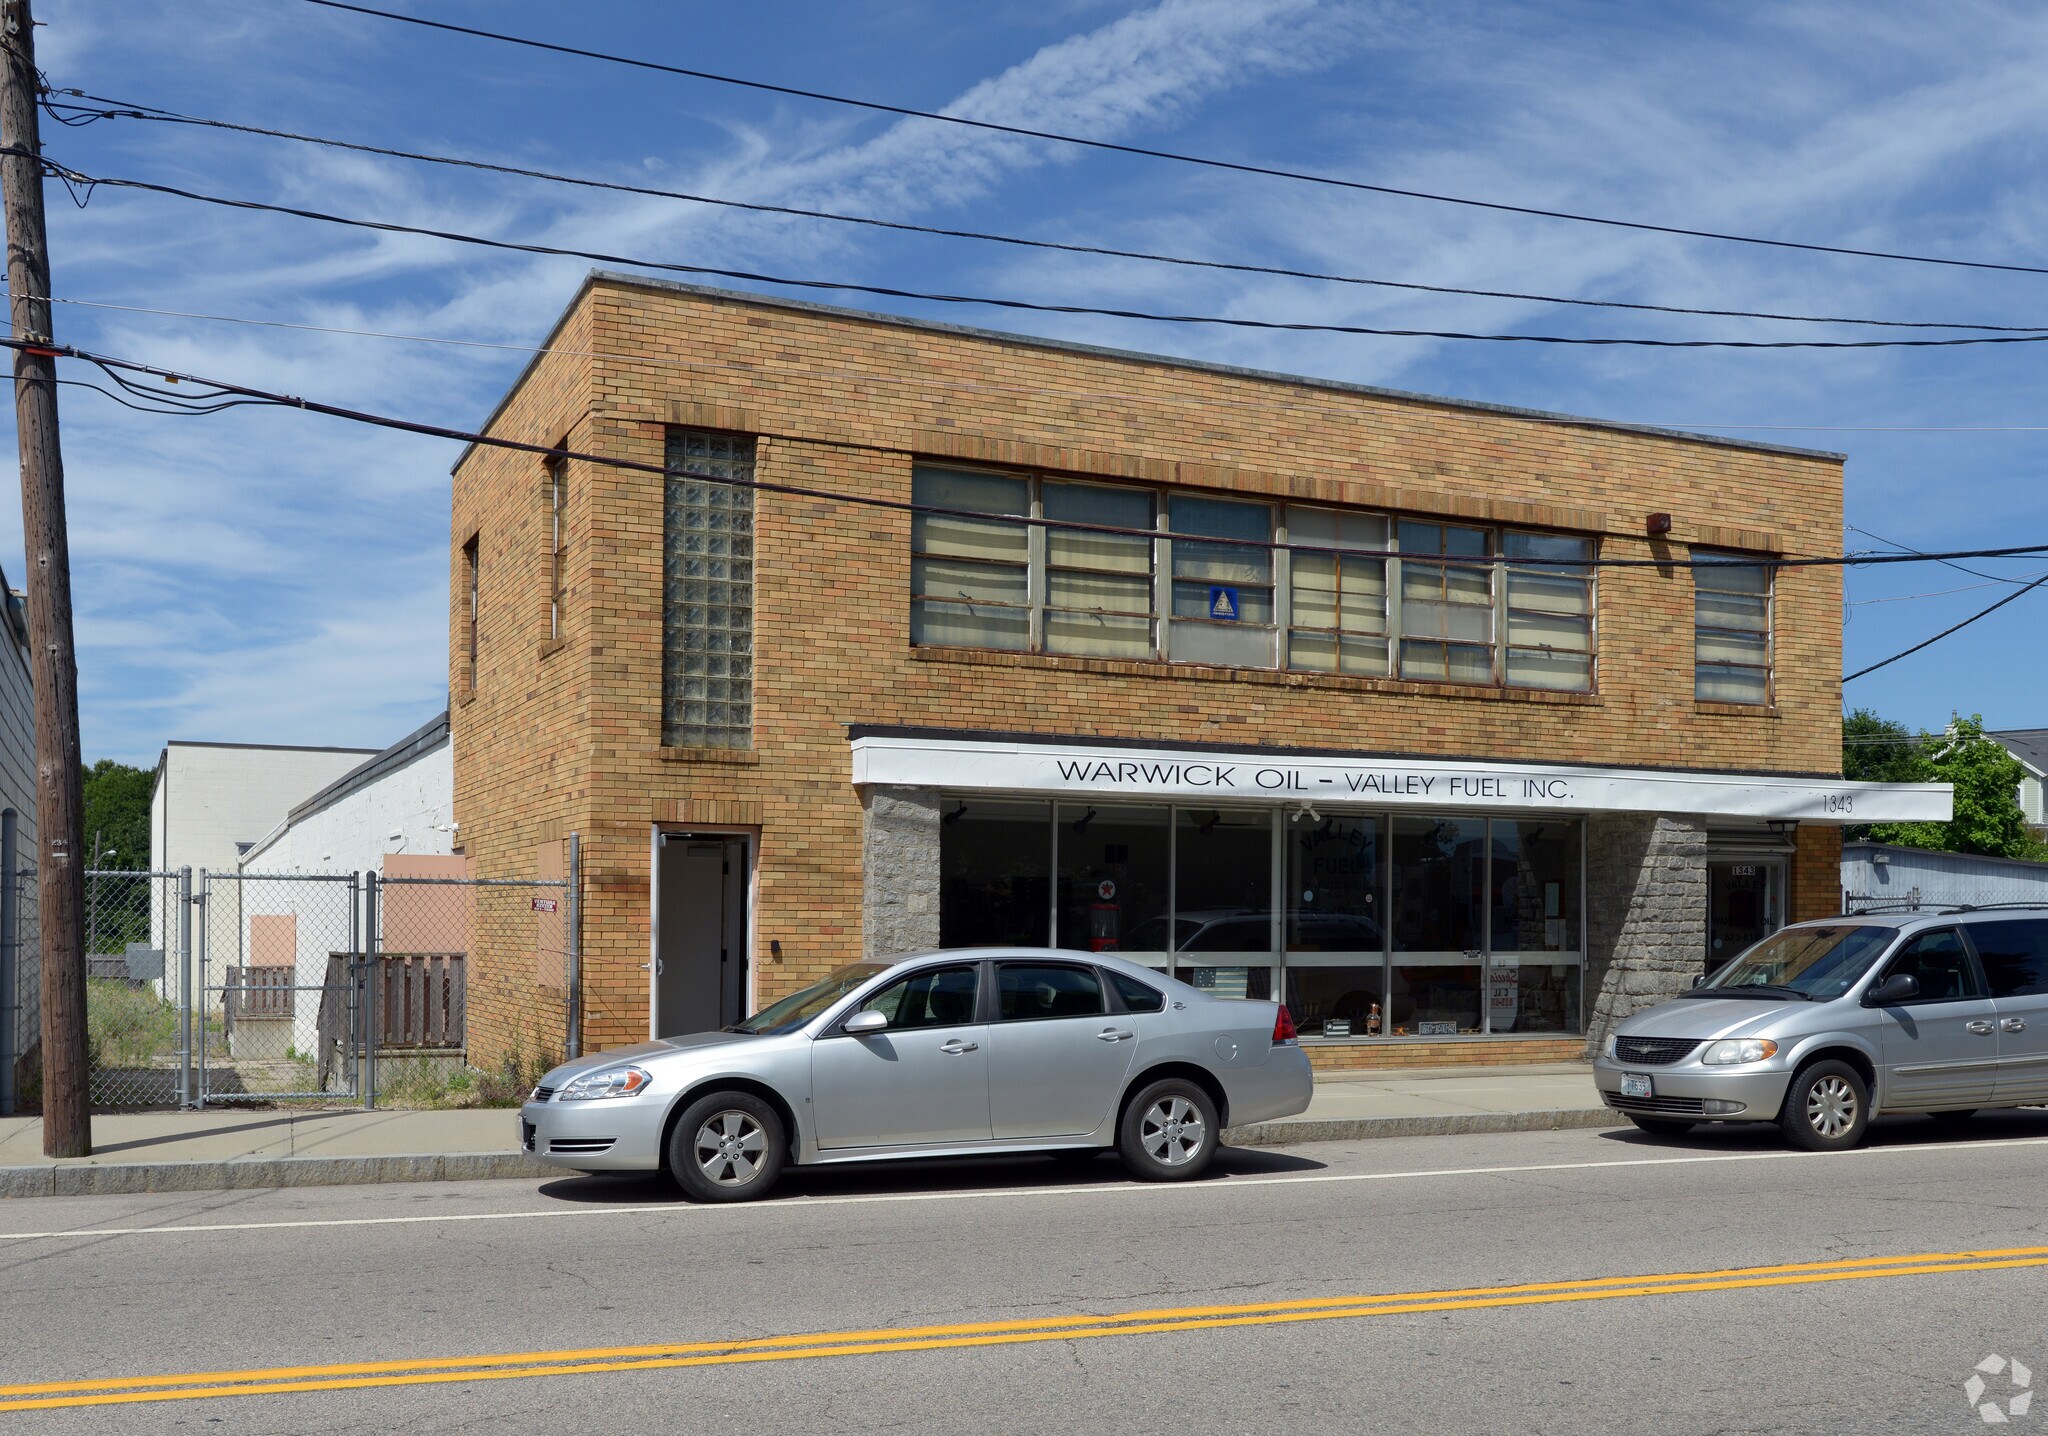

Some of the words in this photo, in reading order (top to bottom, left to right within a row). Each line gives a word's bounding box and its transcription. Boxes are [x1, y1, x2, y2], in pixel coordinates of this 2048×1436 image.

[1056, 760, 1236, 787] WARWICK
[1255, 769, 1309, 790] OIL
[1345, 773, 1436, 795] VALLEY
[1449, 777, 1507, 797] FUEL
[1523, 779, 1575, 799] INC.
[1823, 795, 1853, 813] 1343
[1300, 824, 1373, 852] VALLEY
[1314, 857, 1362, 874] FUEL
[1733, 866, 1755, 875] 1343
[1759, 917, 1776, 926] OIL
